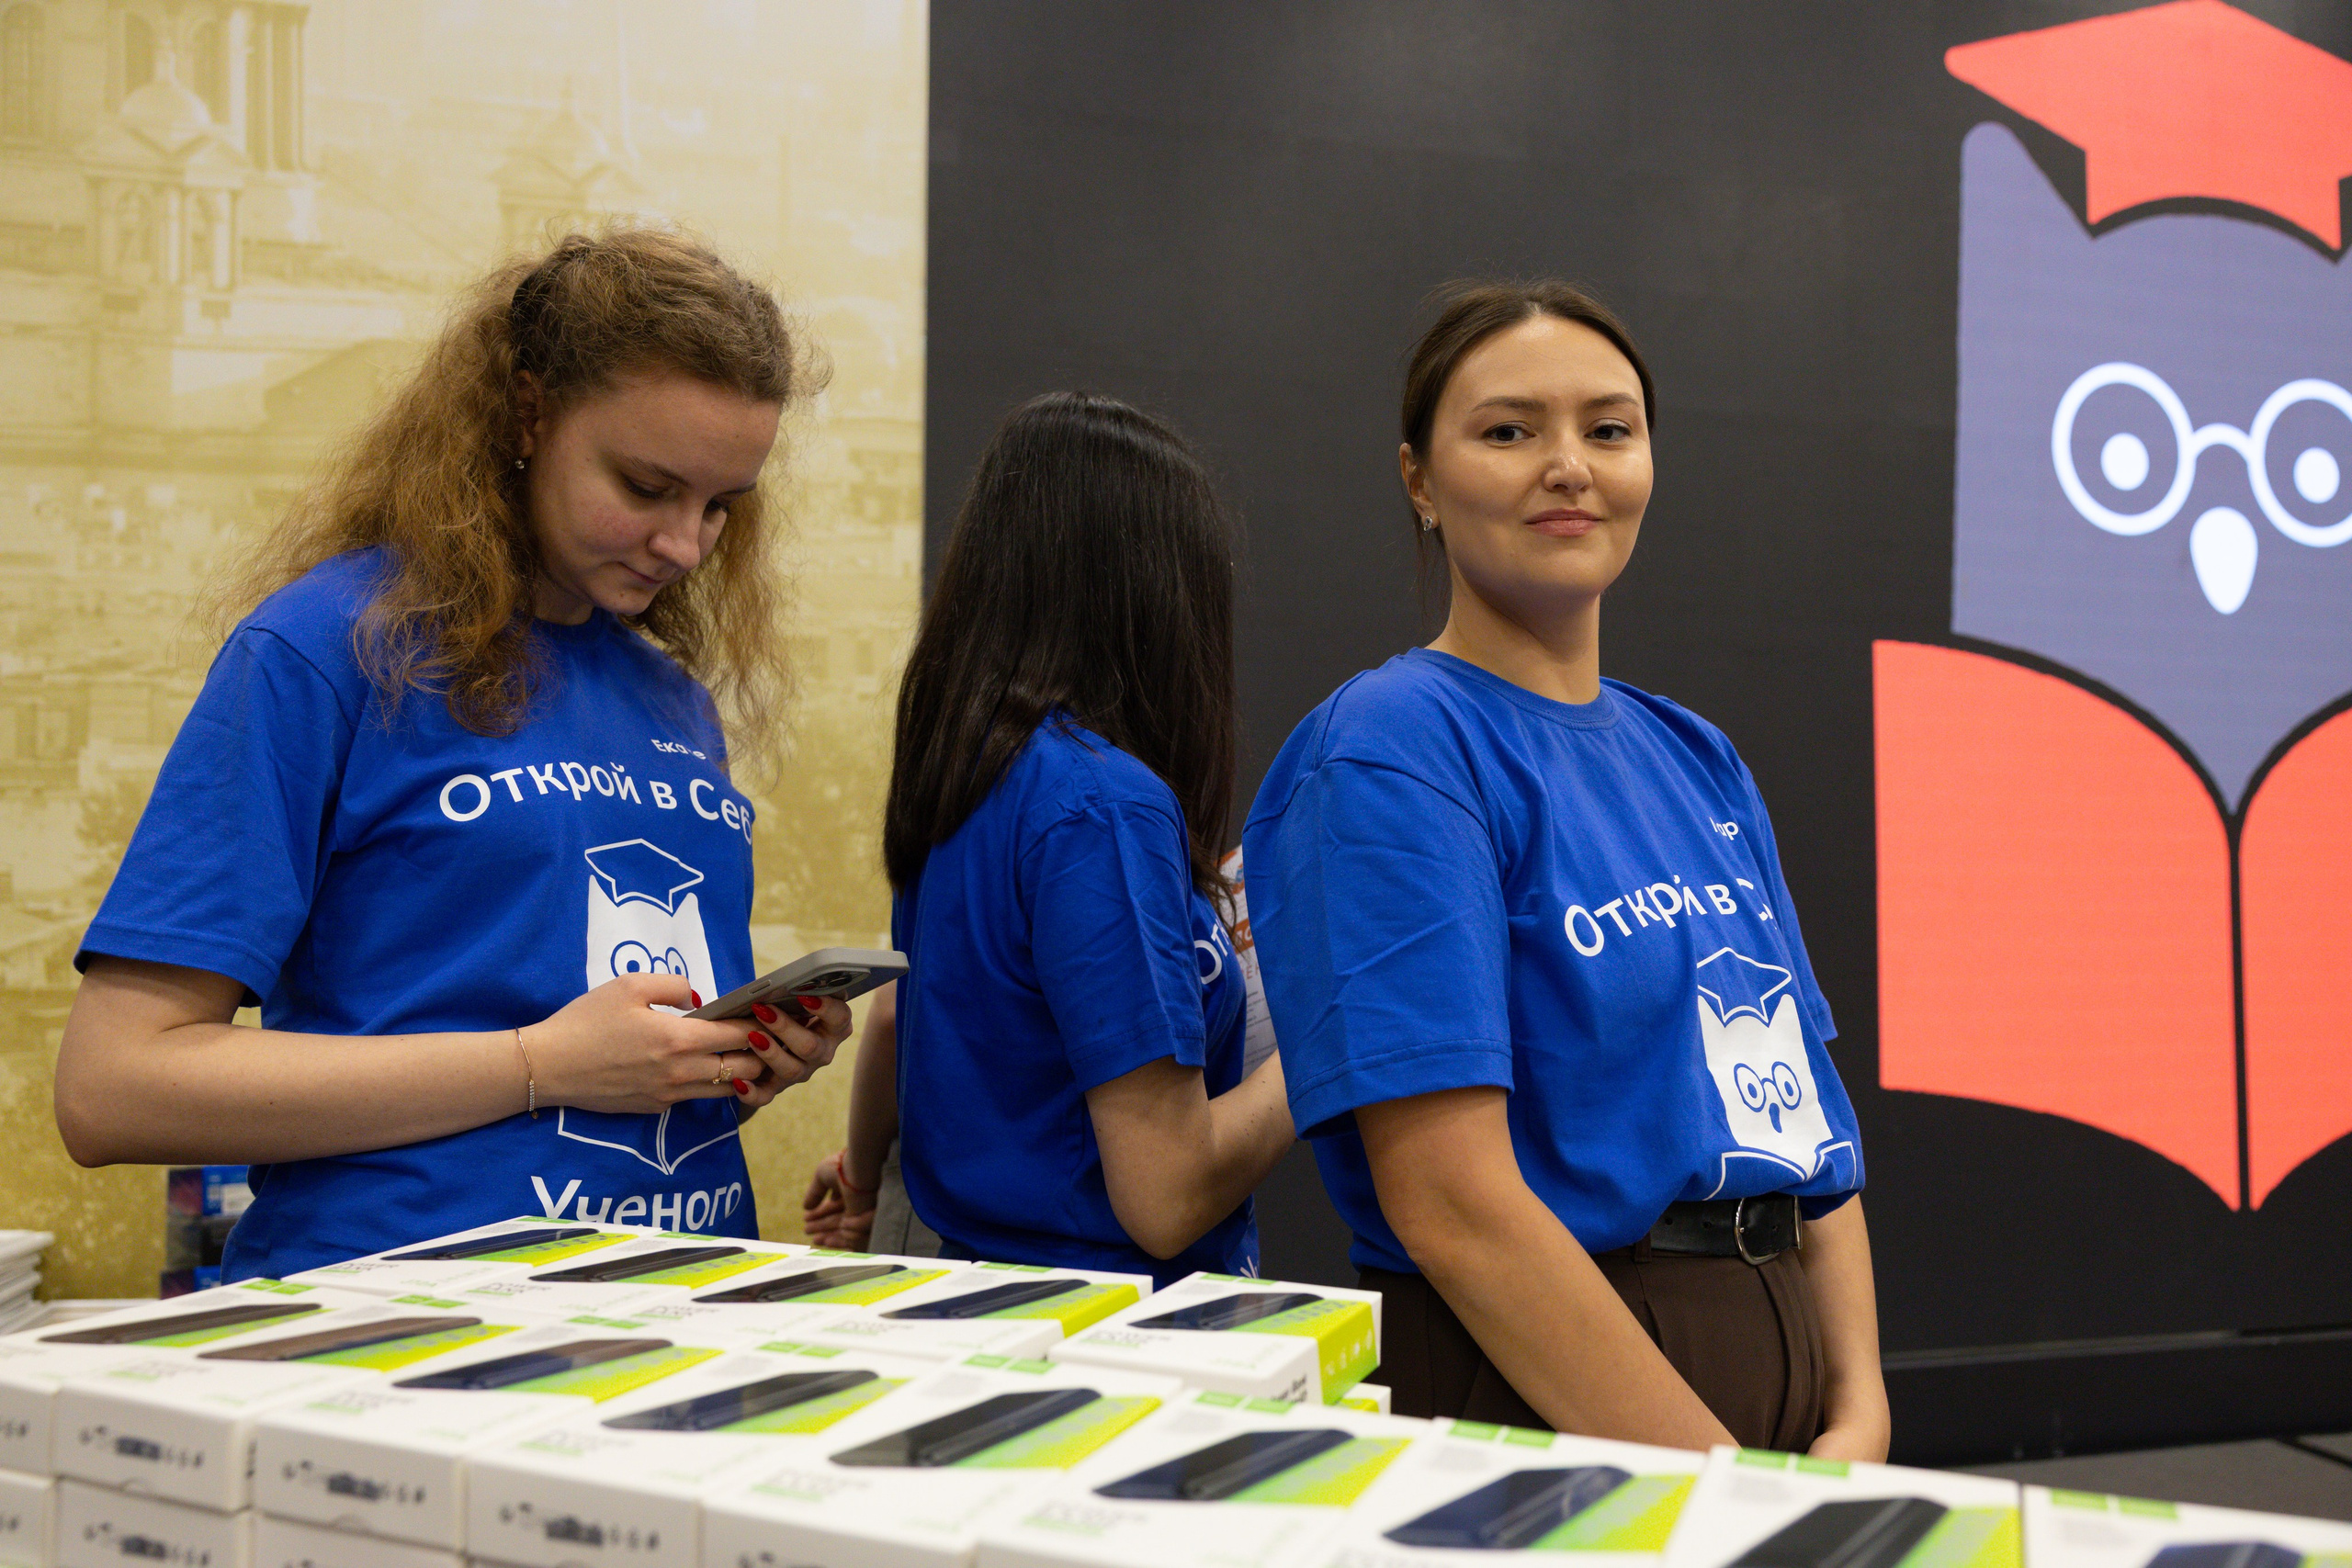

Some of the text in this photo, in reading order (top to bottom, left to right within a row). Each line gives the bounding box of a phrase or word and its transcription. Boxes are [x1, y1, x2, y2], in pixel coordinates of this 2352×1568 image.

[439, 761, 641, 822] Открой
[649, 780, 678, 810] в
[1705, 884, 1738, 916] в
[530, 1176, 742, 1233] Ученого
